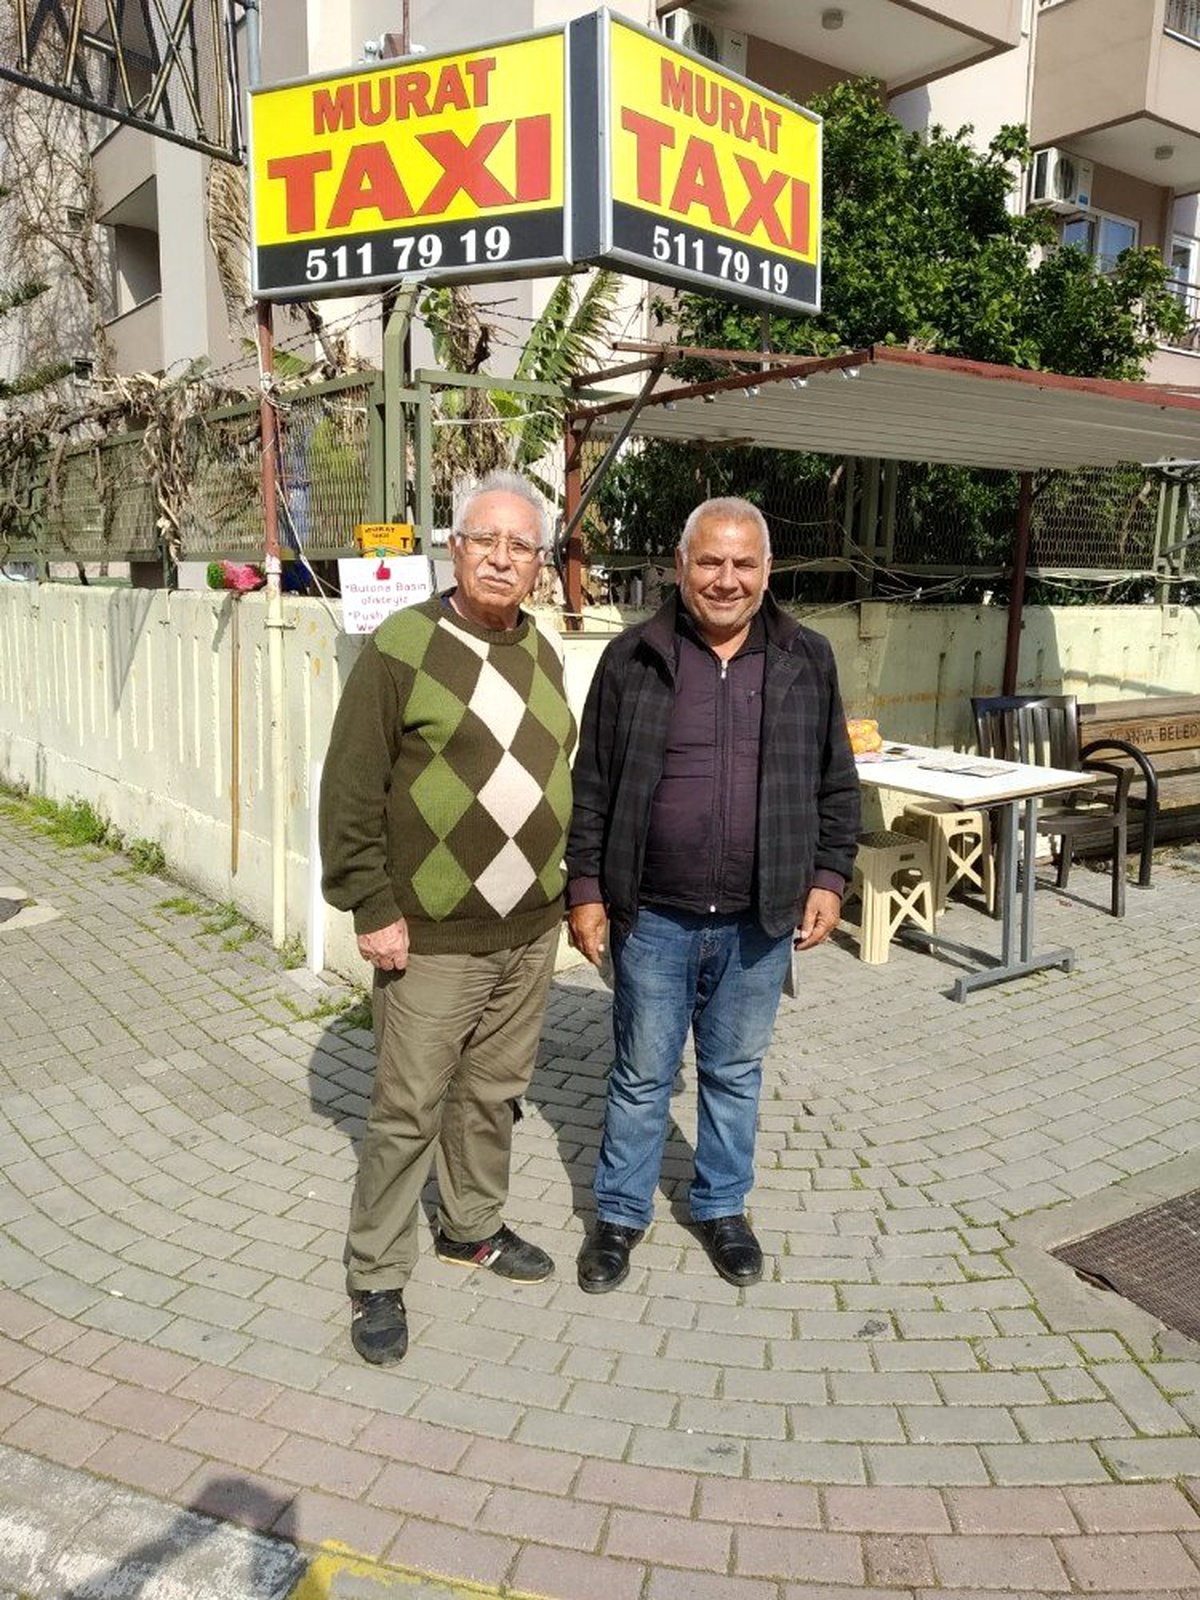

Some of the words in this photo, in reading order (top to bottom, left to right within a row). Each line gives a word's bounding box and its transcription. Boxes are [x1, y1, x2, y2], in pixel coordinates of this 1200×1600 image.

[312, 56, 496, 135] MURAT
[660, 56, 782, 154] MURAT
[267, 113, 551, 234] TAXI
[620, 105, 810, 256] TAXI
[305, 242, 372, 281] 511
[393, 234, 443, 271] 79
[460, 226, 511, 264] 19
[653, 225, 704, 271] 511
[717, 246, 750, 284] 79
[759, 260, 789, 294] 19
